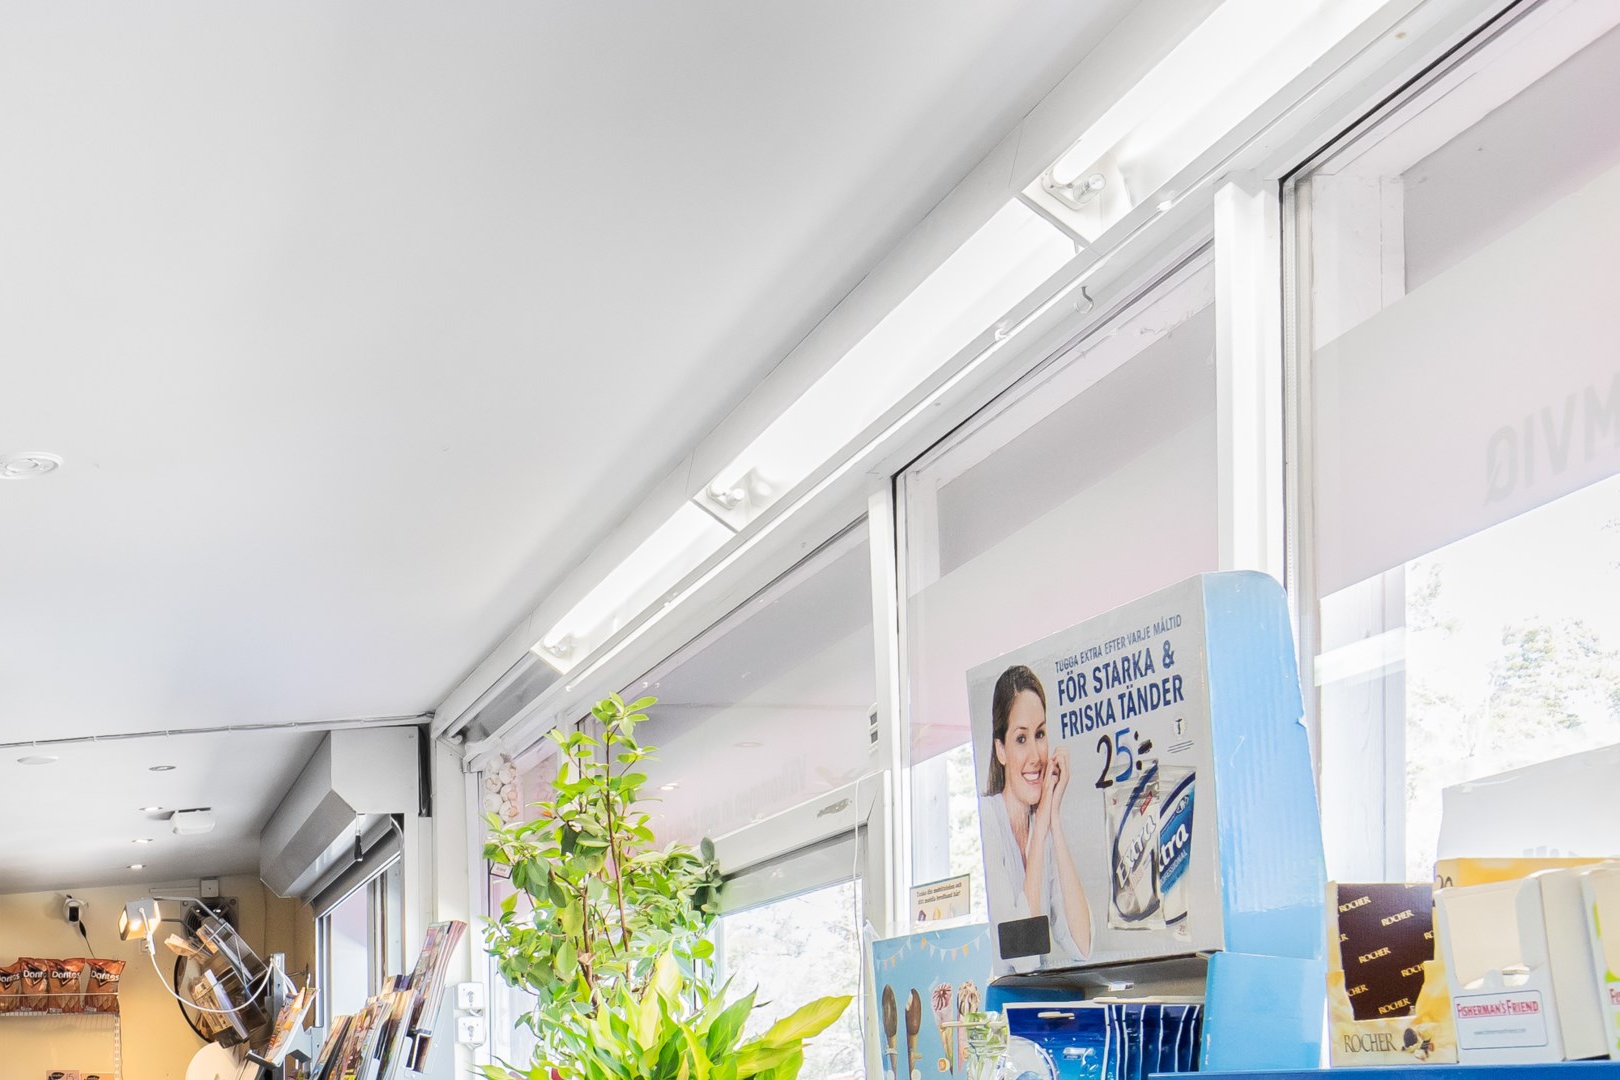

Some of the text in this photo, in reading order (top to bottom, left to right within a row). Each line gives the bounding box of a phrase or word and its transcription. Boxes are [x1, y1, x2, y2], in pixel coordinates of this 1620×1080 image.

[1054, 613, 1182, 674] TUGGA EXTRA EFTER VARJE MÅLTID
[1057, 639, 1176, 706] FÖR STARKA &
[1060, 674, 1185, 740] FRISKA TÄNDER
[1095, 727, 1153, 789] 25:-
[1115, 814, 1157, 889] Extra
[1338, 895, 1372, 914] ROCHER
[1380, 908, 1415, 927] ROCHER
[1357, 946, 1392, 965] ROCHER
[51, 970, 80, 980] Doritos
[90, 970, 120, 982] Doritos
[1378, 997, 1411, 1016] ROCHER
[1344, 1032, 1397, 1054] ROCHER
